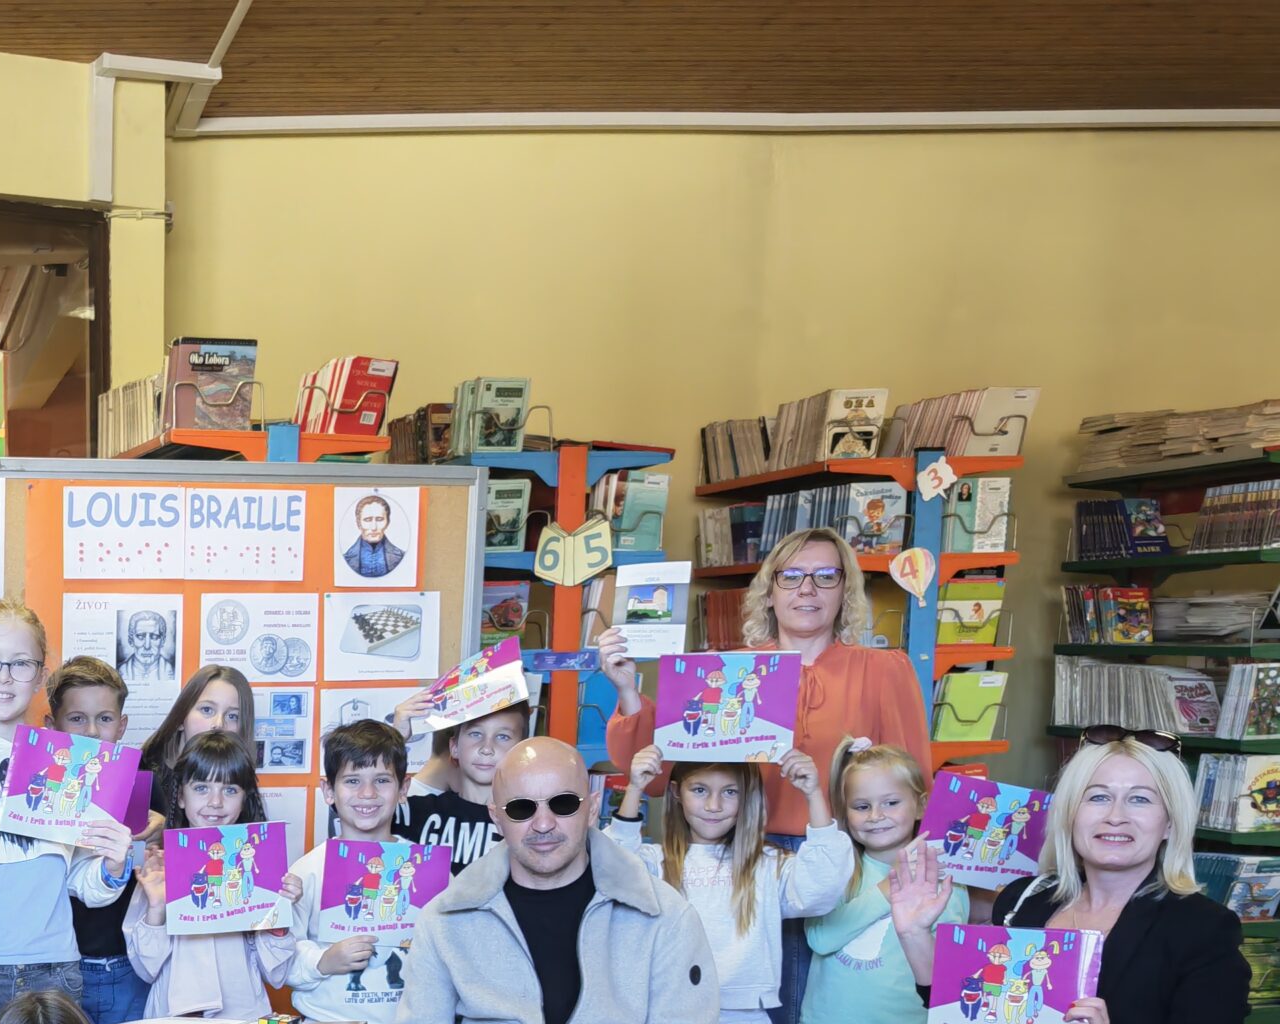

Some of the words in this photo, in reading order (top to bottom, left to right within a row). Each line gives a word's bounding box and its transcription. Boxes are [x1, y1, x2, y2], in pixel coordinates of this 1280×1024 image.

[189, 353, 203, 364] Oko
[205, 353, 230, 365] Lobora
[926, 467, 943, 490] 3
[67, 491, 180, 528] LOUIS
[189, 493, 302, 532] BRAILLE
[538, 536, 561, 572] 6
[583, 532, 609, 568] 5
[899, 555, 919, 580] 4
[75, 599, 110, 610] ŽIVOT
[865, 957, 885, 971] LOVE
